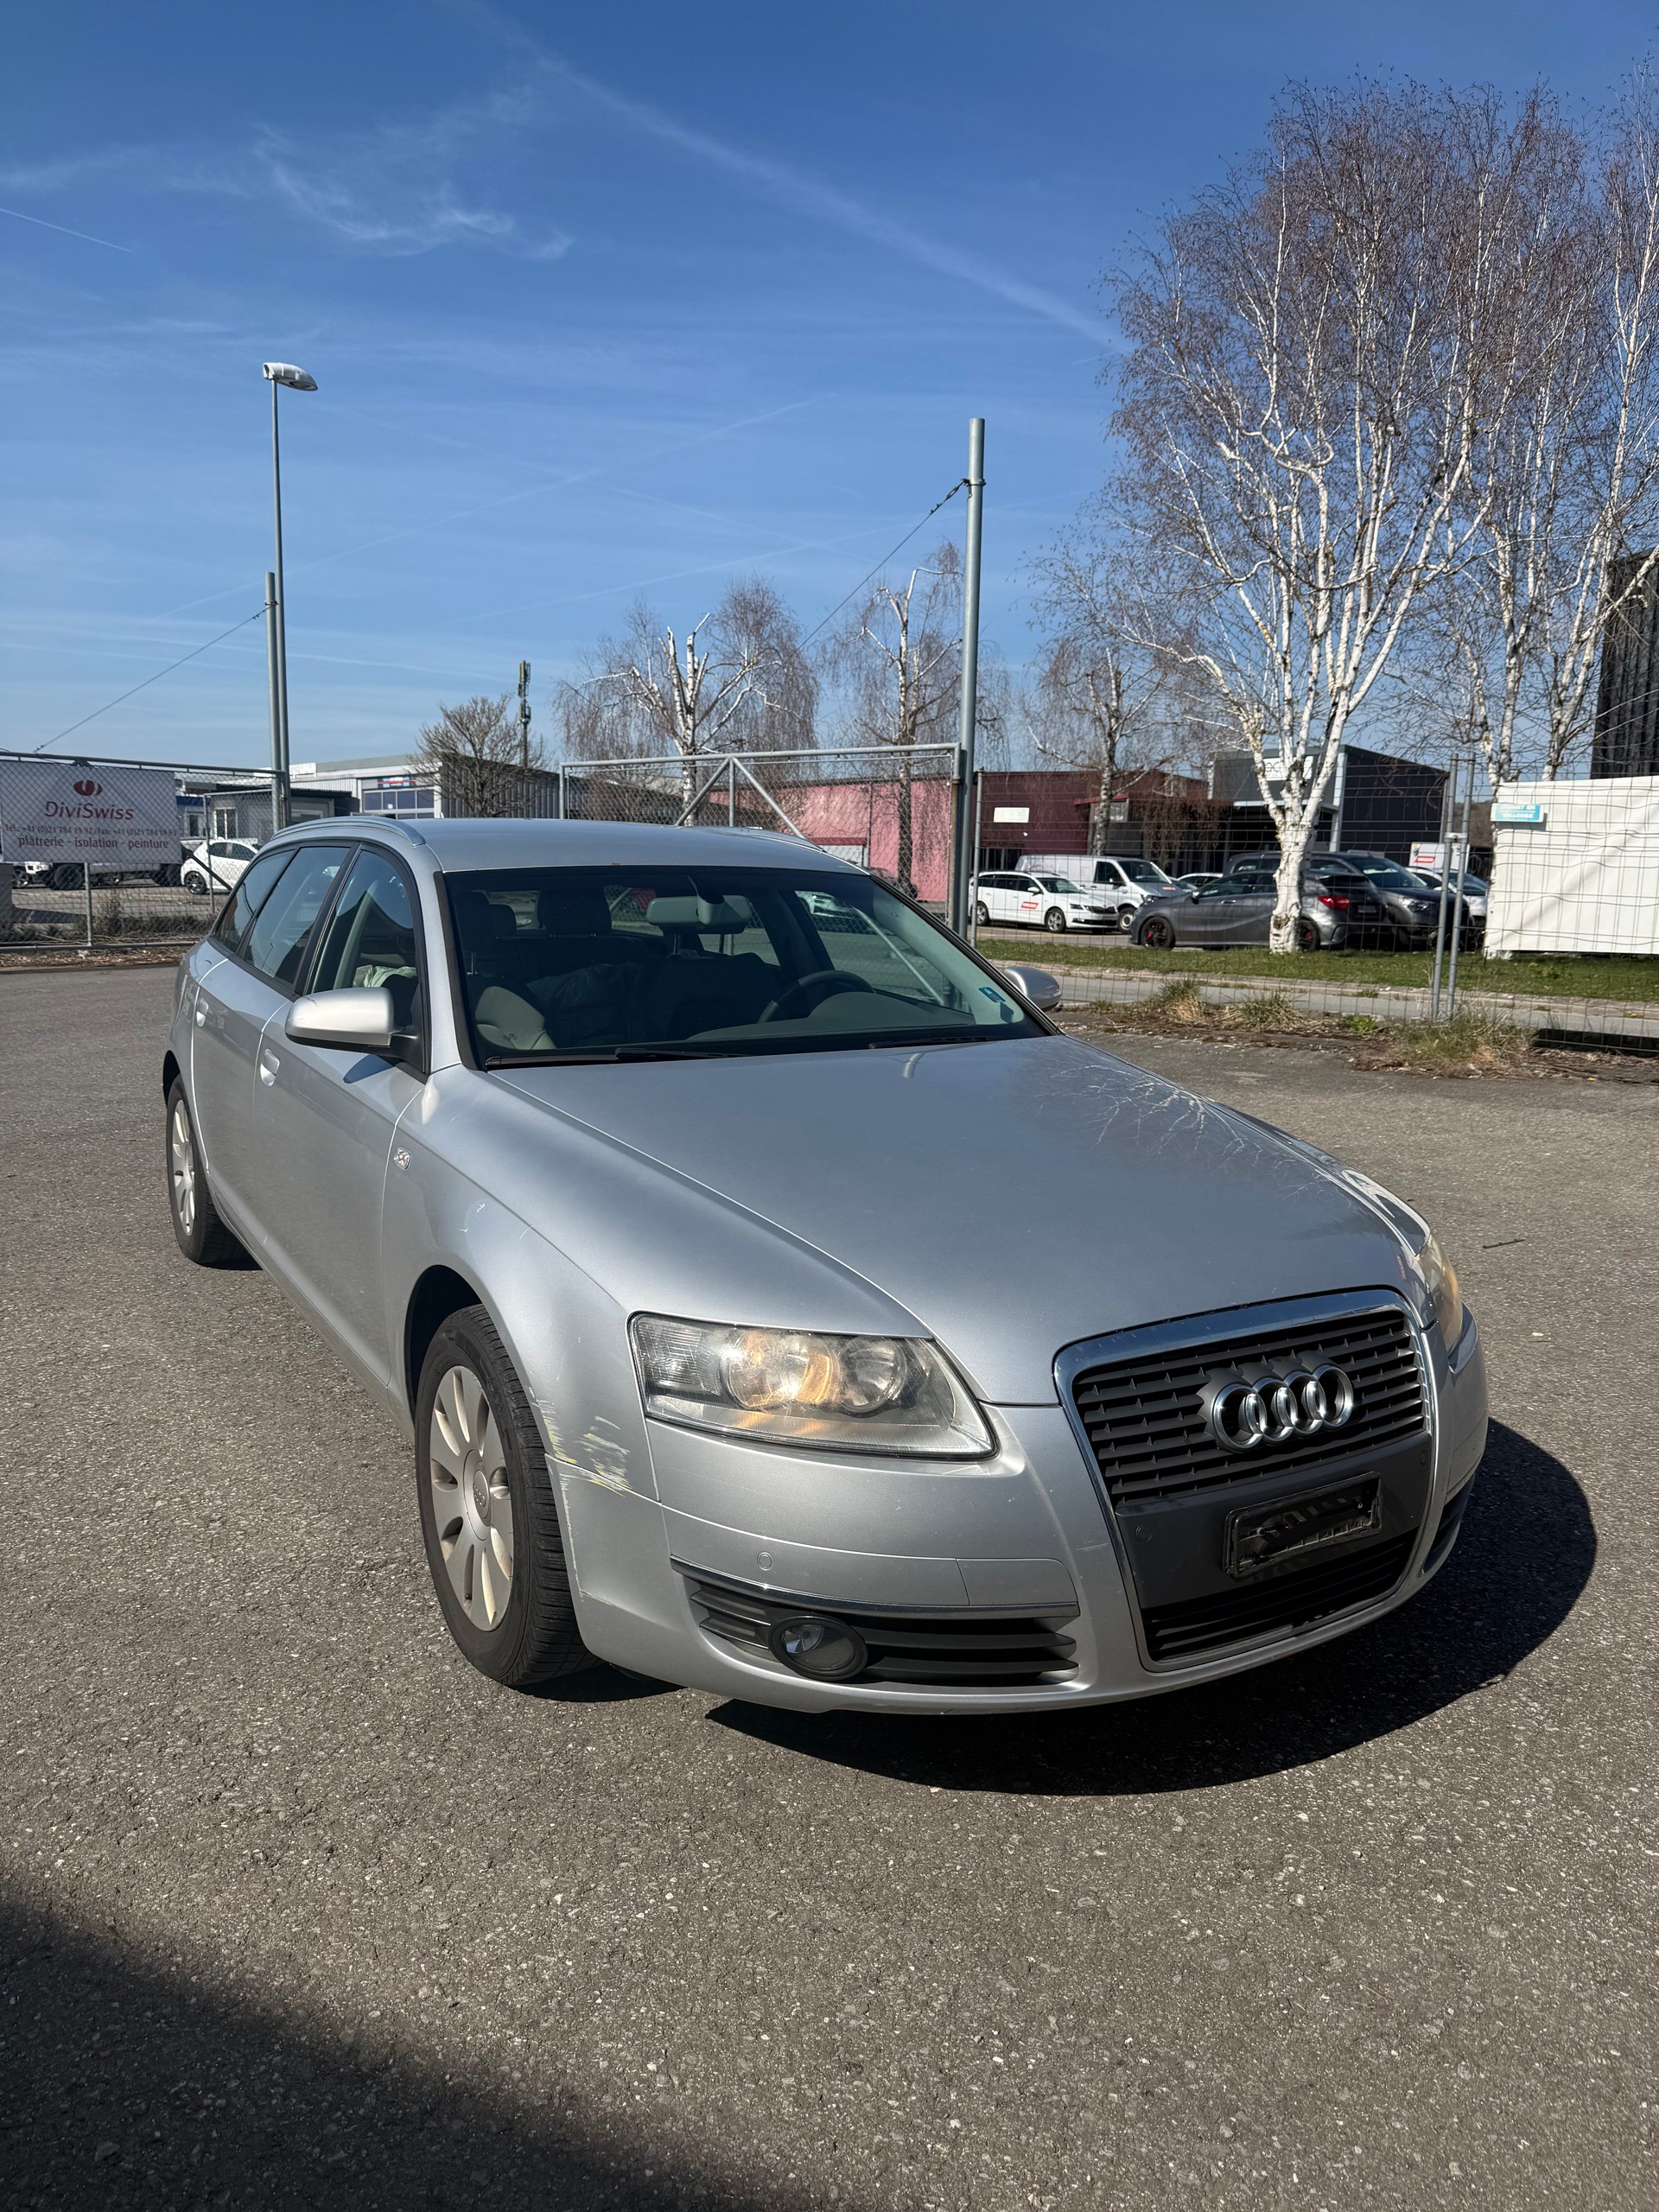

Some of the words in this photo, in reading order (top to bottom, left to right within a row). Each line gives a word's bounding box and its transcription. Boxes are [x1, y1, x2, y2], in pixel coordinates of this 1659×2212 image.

[45, 801, 134, 820] DiviSwiss
[18, 835, 64, 848] plâtrerie
[74, 836, 118, 849] isolation
[128, 838, 169, 850] peinture
